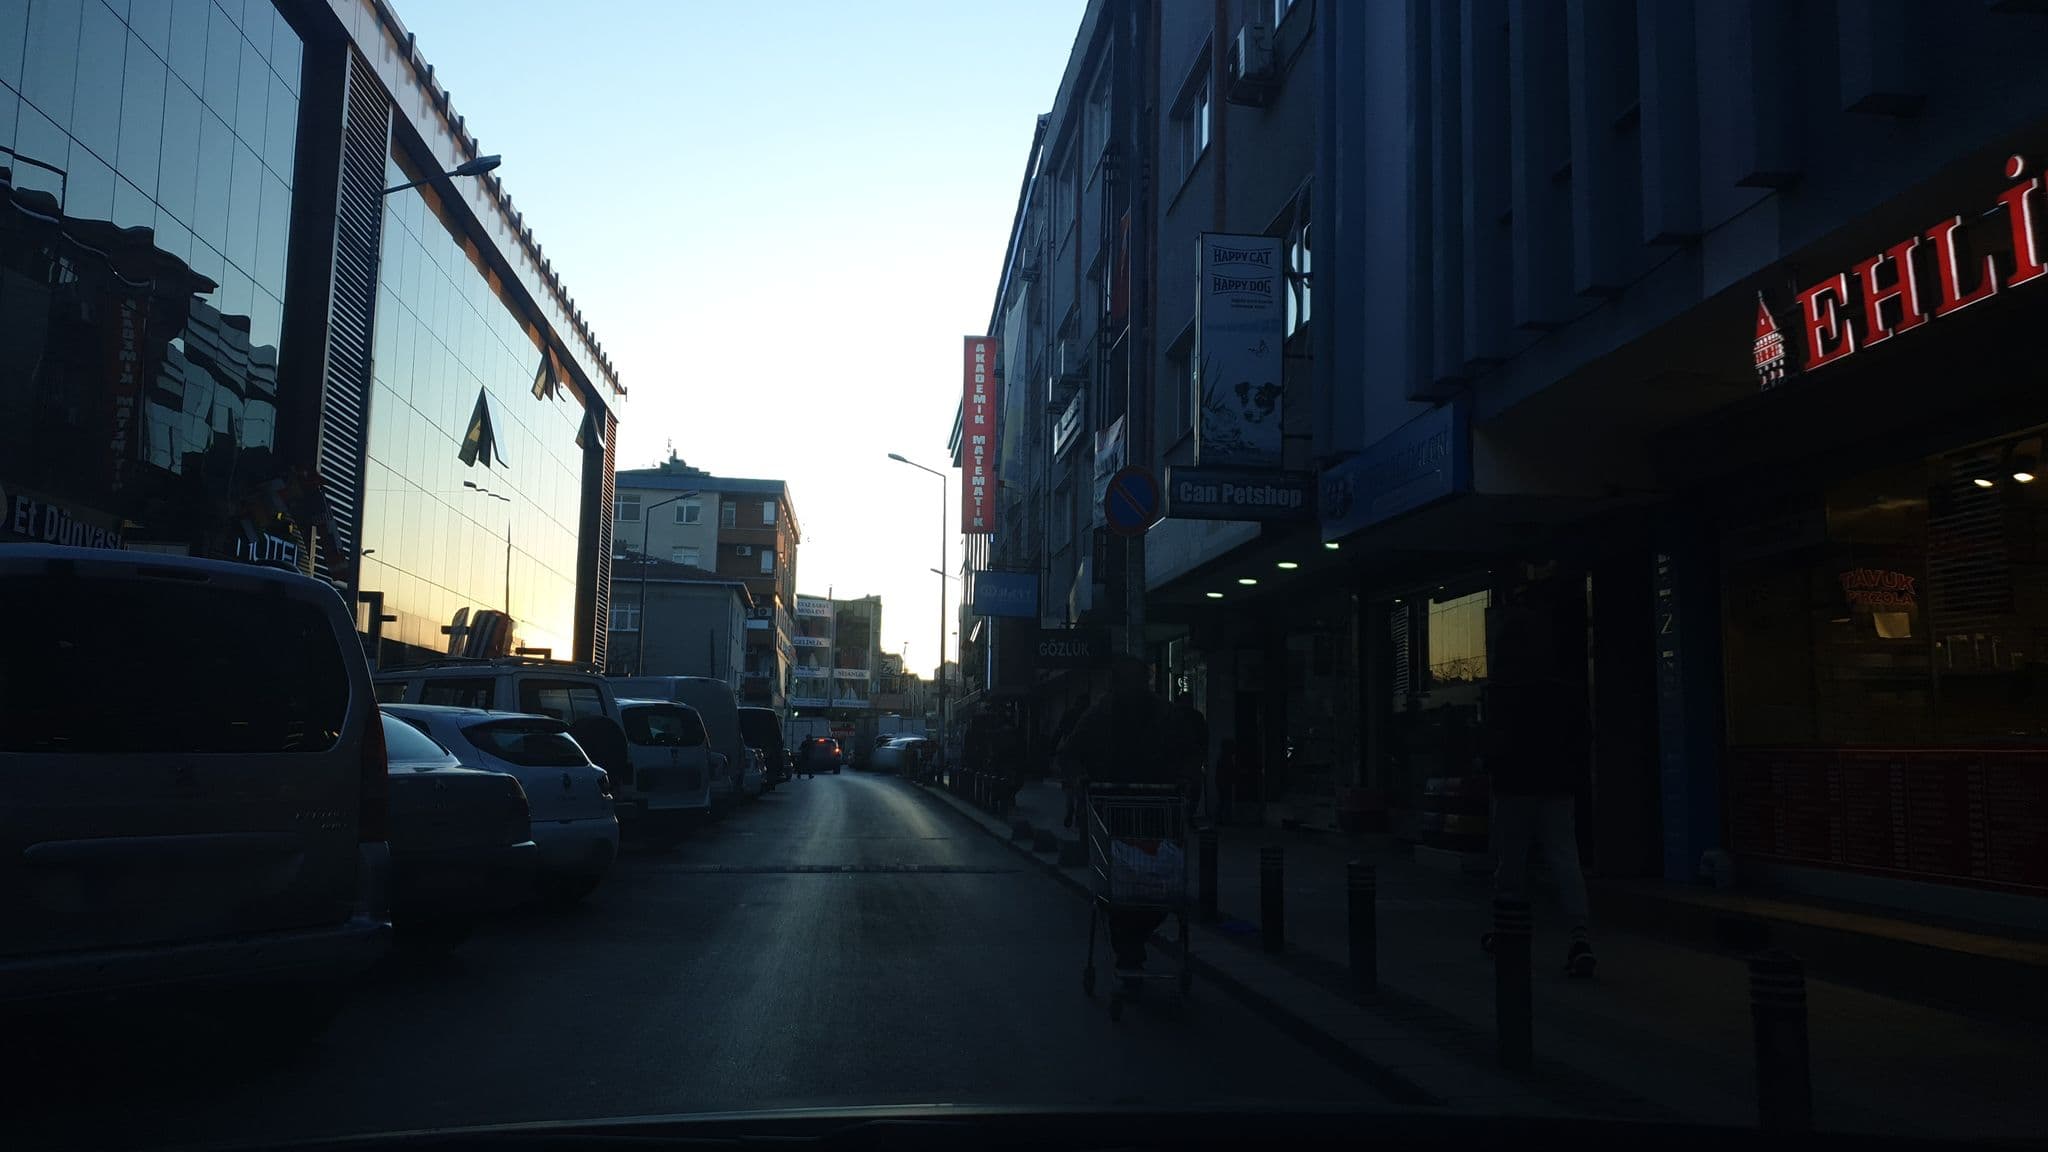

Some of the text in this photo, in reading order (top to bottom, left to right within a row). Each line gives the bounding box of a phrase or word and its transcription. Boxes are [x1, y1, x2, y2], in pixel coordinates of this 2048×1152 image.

[1214, 248, 1272, 265] HAPPY CAT
[1214, 277, 1272, 294] HAPPY DOG
[1180, 481, 1303, 509] Can Petshop
